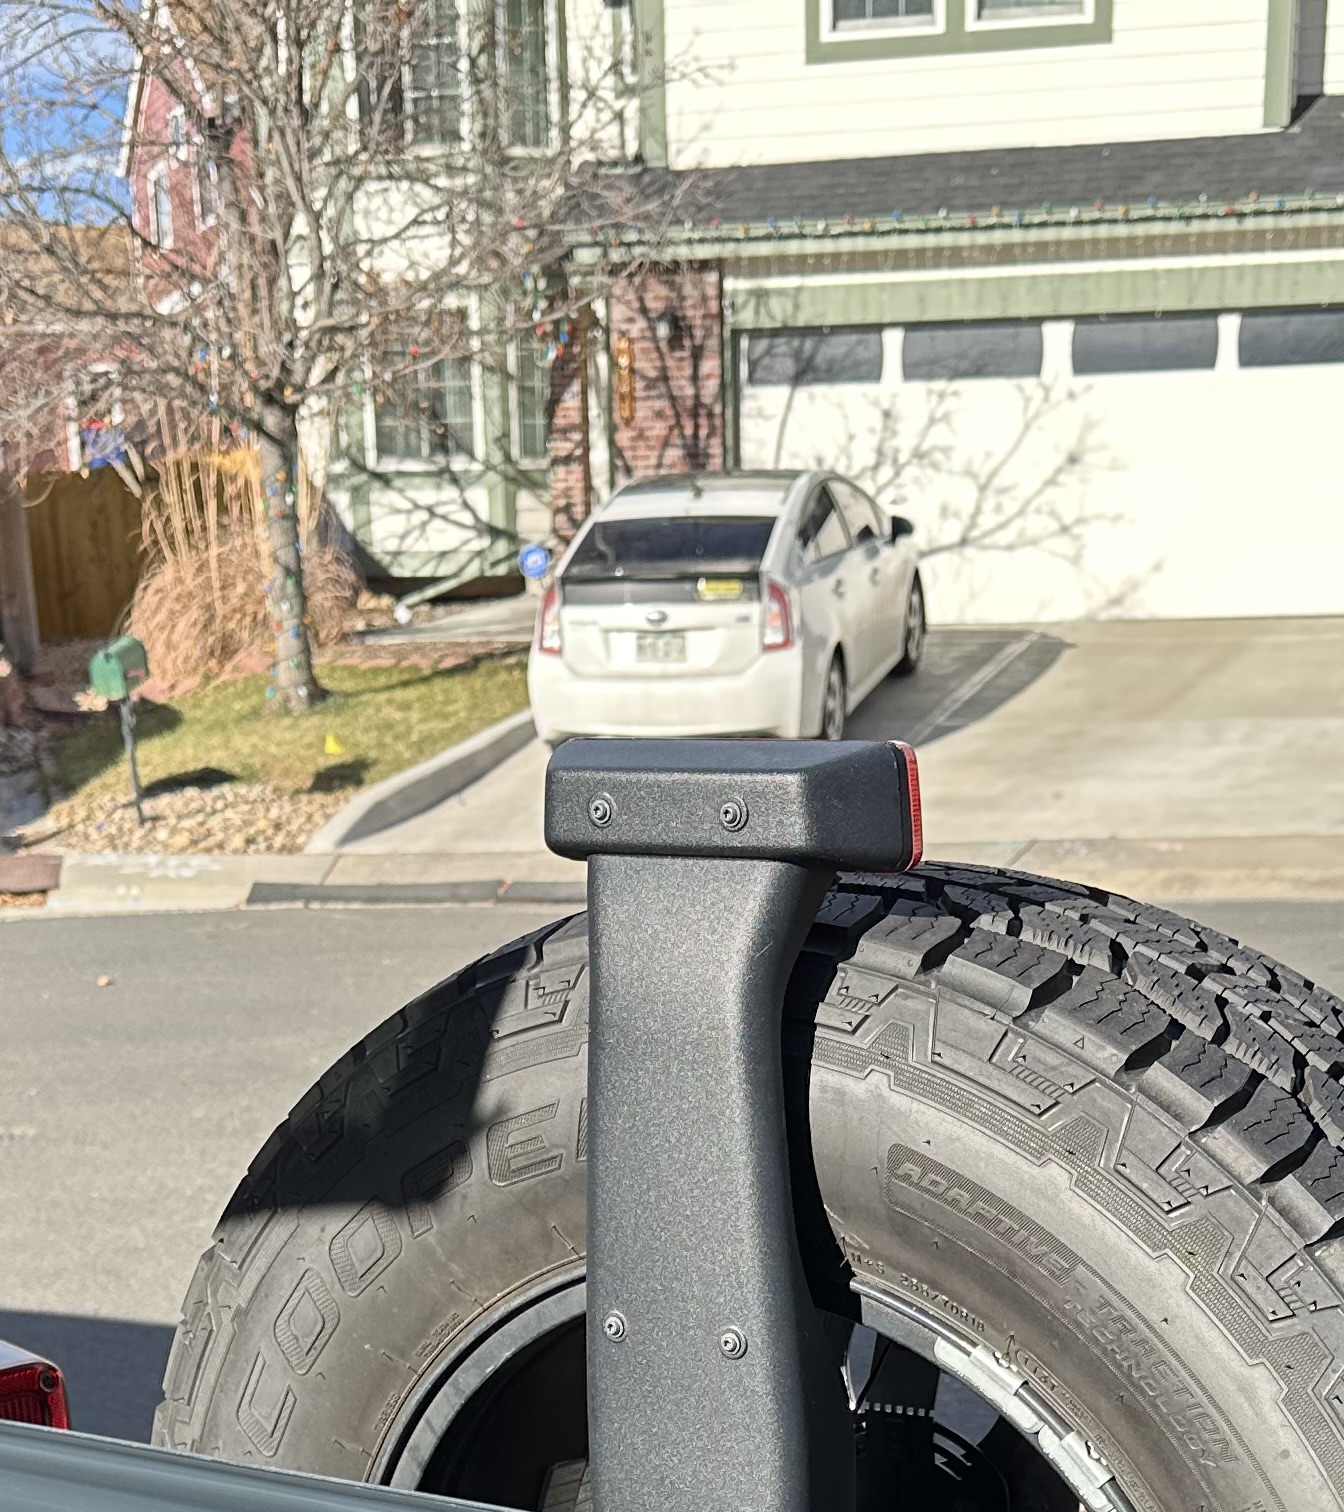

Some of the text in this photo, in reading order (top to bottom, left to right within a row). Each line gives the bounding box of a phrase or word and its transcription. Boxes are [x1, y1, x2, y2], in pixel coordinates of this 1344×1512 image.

[236, 1097, 588, 1458] COOPE
[893, 1162, 1071, 1277] ADAPTIVE
[1095, 1293, 1240, 1464] TRACTION
[1063, 1297, 1218, 1467] TECHNOLOGY
